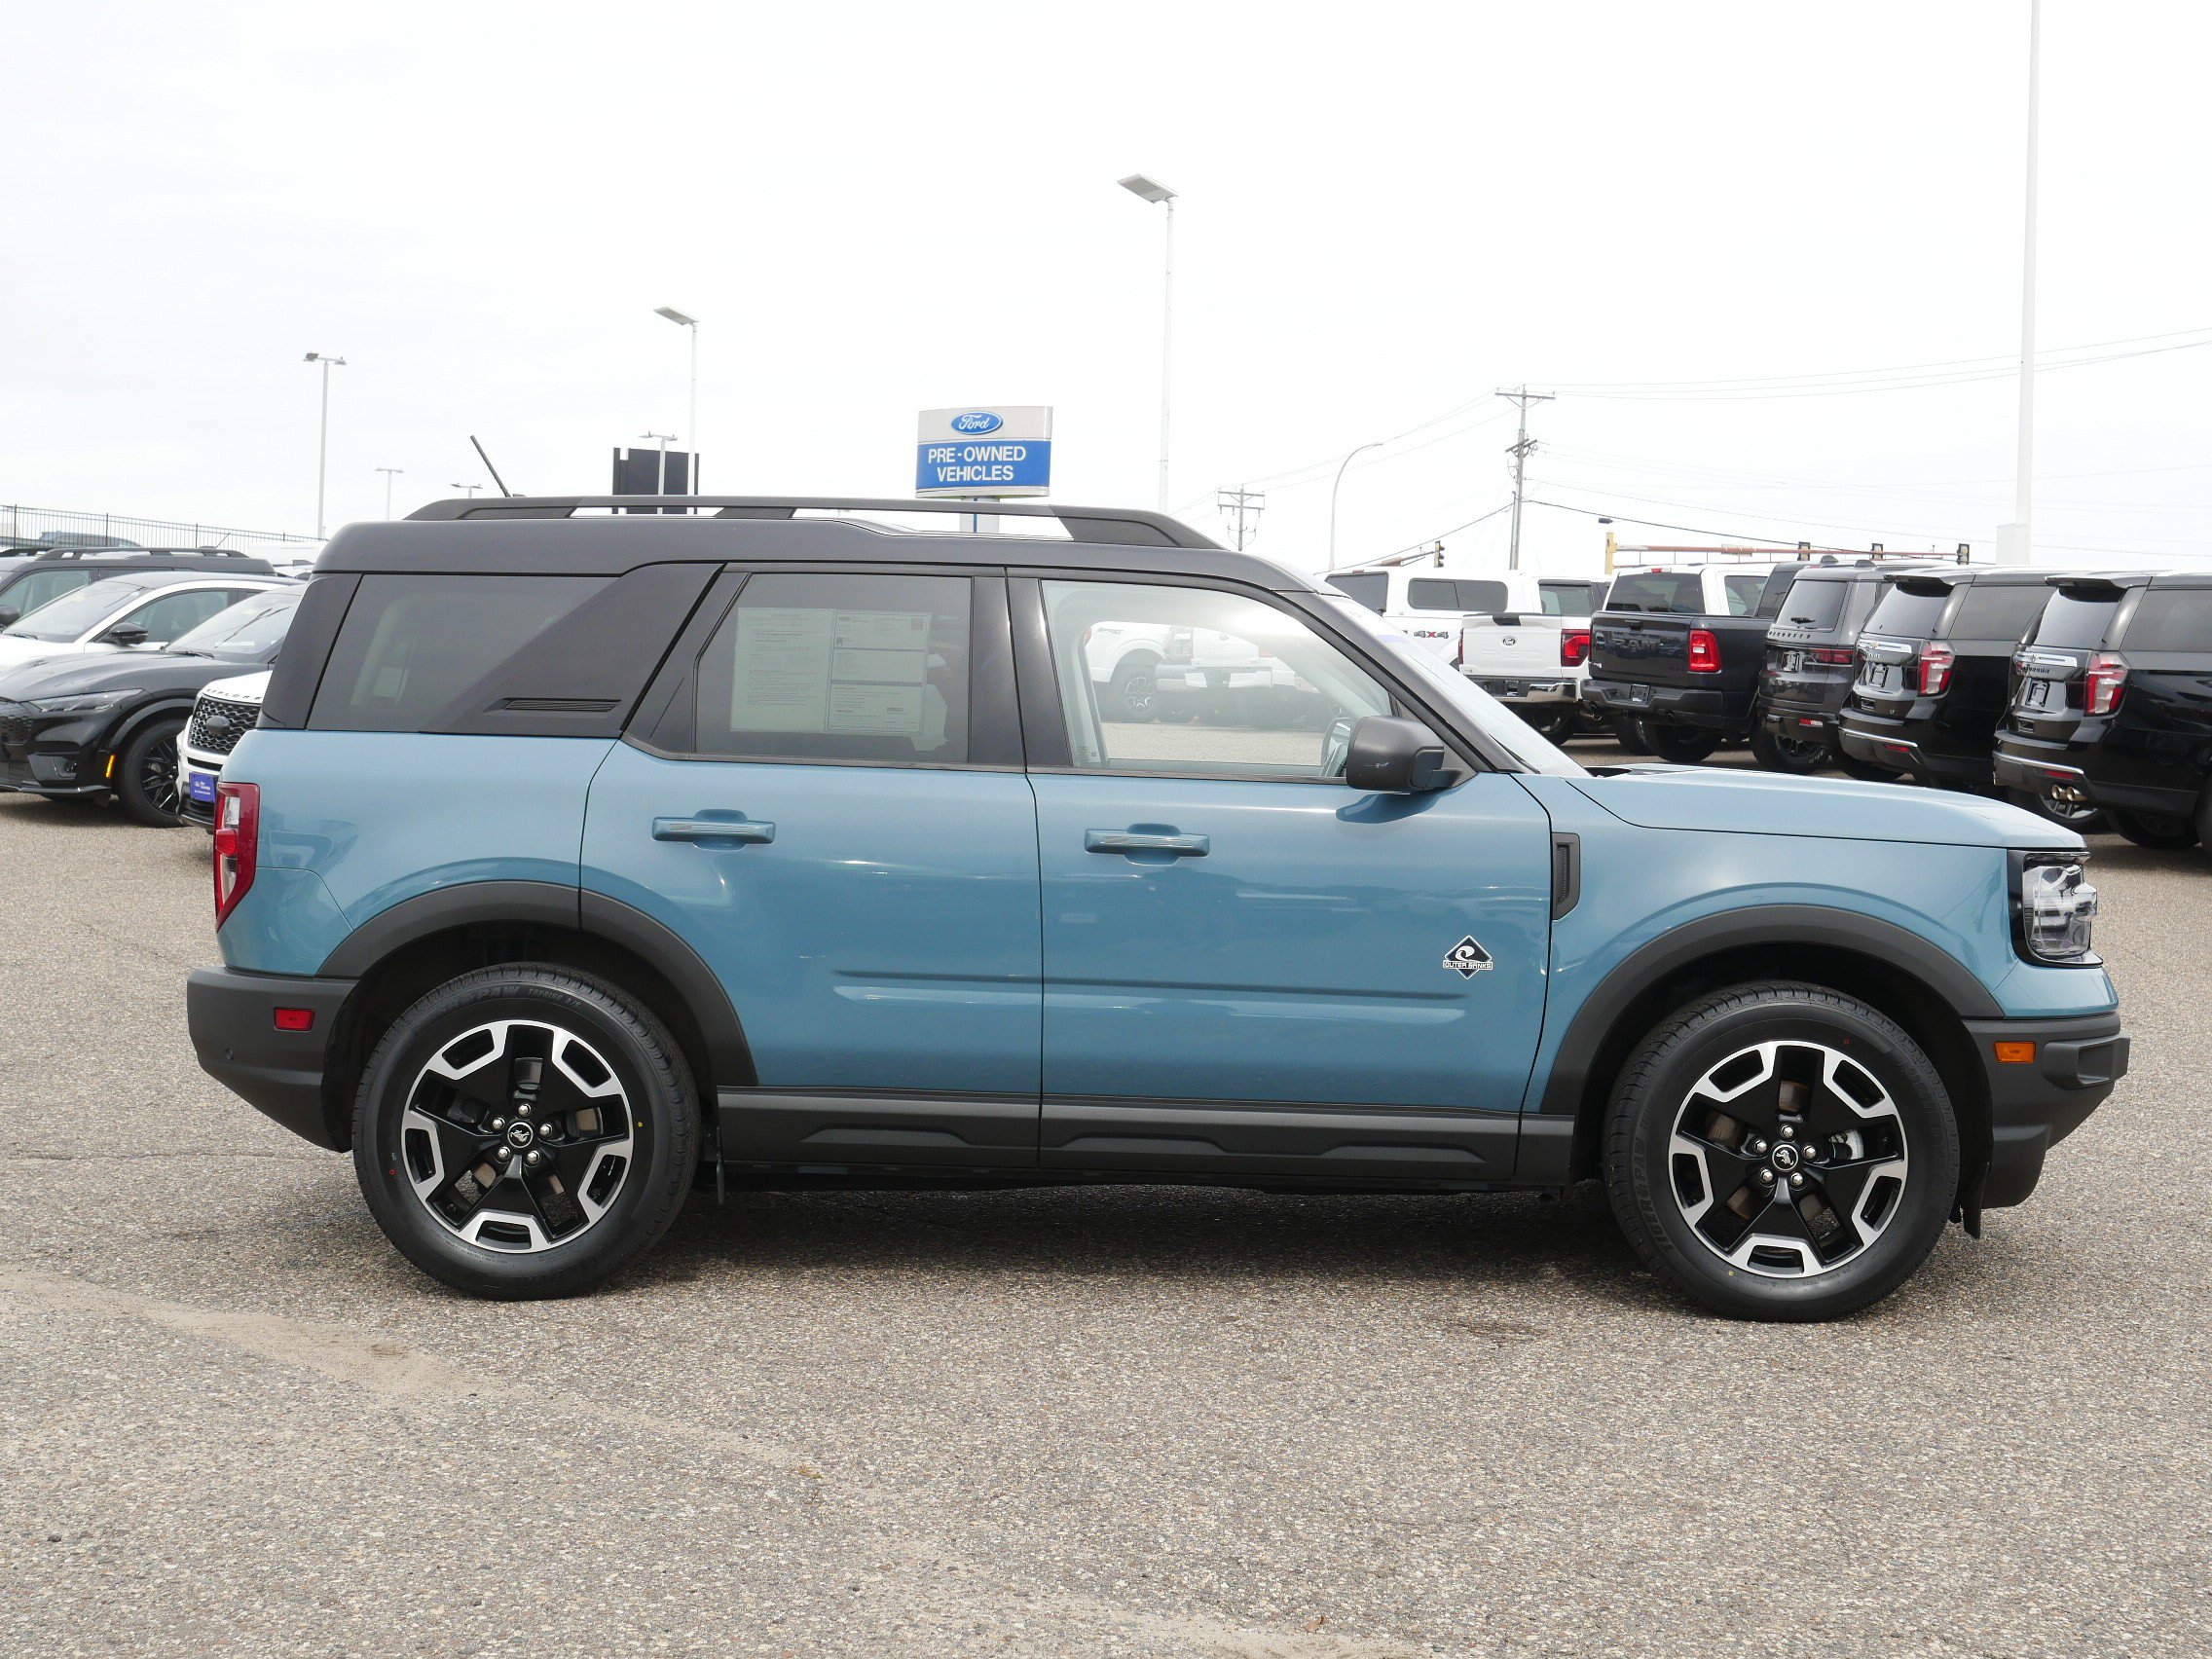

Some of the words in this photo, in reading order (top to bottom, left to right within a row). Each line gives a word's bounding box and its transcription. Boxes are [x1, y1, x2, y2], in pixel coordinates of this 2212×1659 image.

[959, 414, 990, 429] Ford
[928, 446, 1026, 463] PRE-OWNED
[937, 465, 1014, 481] VEHICLES
[1612, 638, 1661, 652] RAM
[206, 688, 263, 700] EXPLORE
